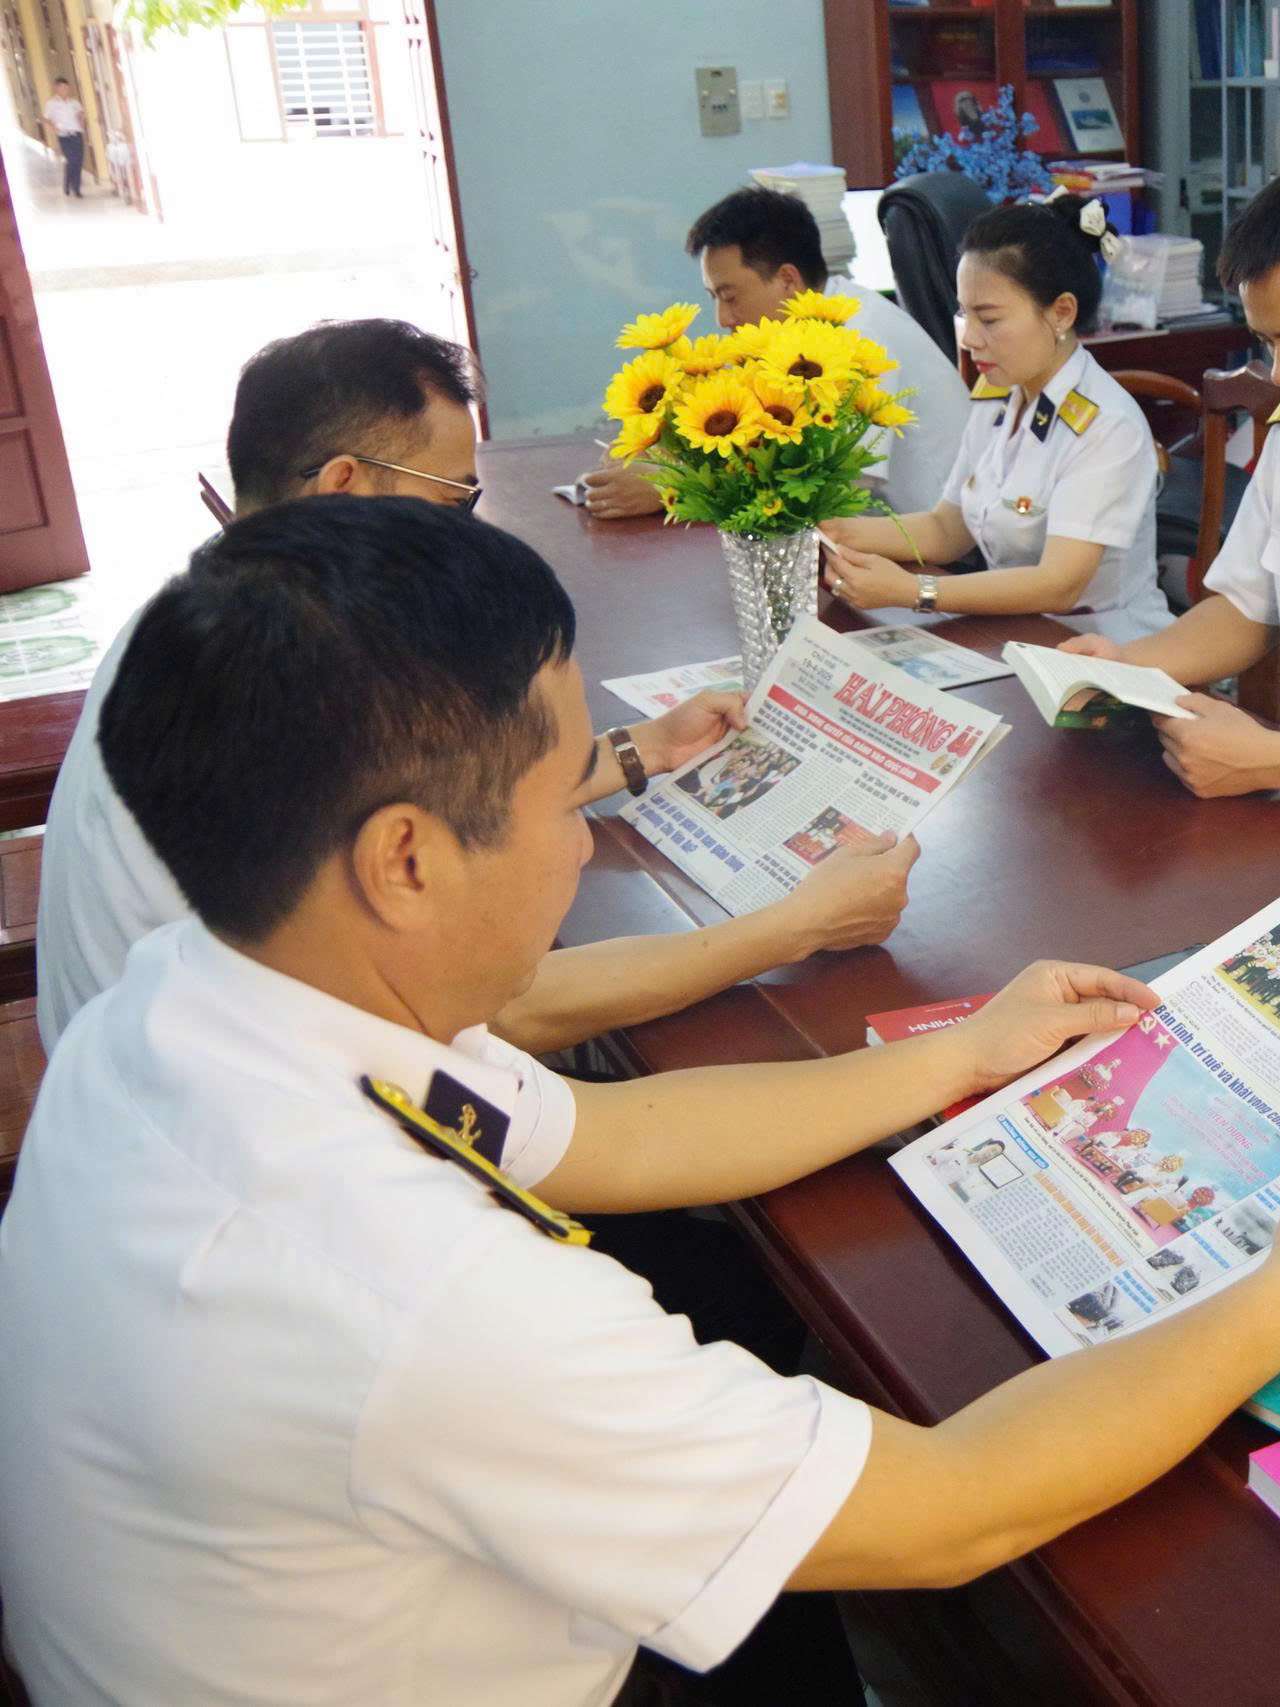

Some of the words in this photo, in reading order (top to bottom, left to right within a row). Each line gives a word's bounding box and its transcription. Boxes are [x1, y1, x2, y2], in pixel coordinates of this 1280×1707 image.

[833, 666, 895, 723] HẢI
[874, 686, 959, 759] PHÒNG
[908, 1018, 954, 1033] MINH
[1189, 1041, 1208, 1059] trí
[1199, 1052, 1223, 1075] tuệ
[1216, 1067, 1234, 1084] và
[1245, 1092, 1272, 1117] vọng
